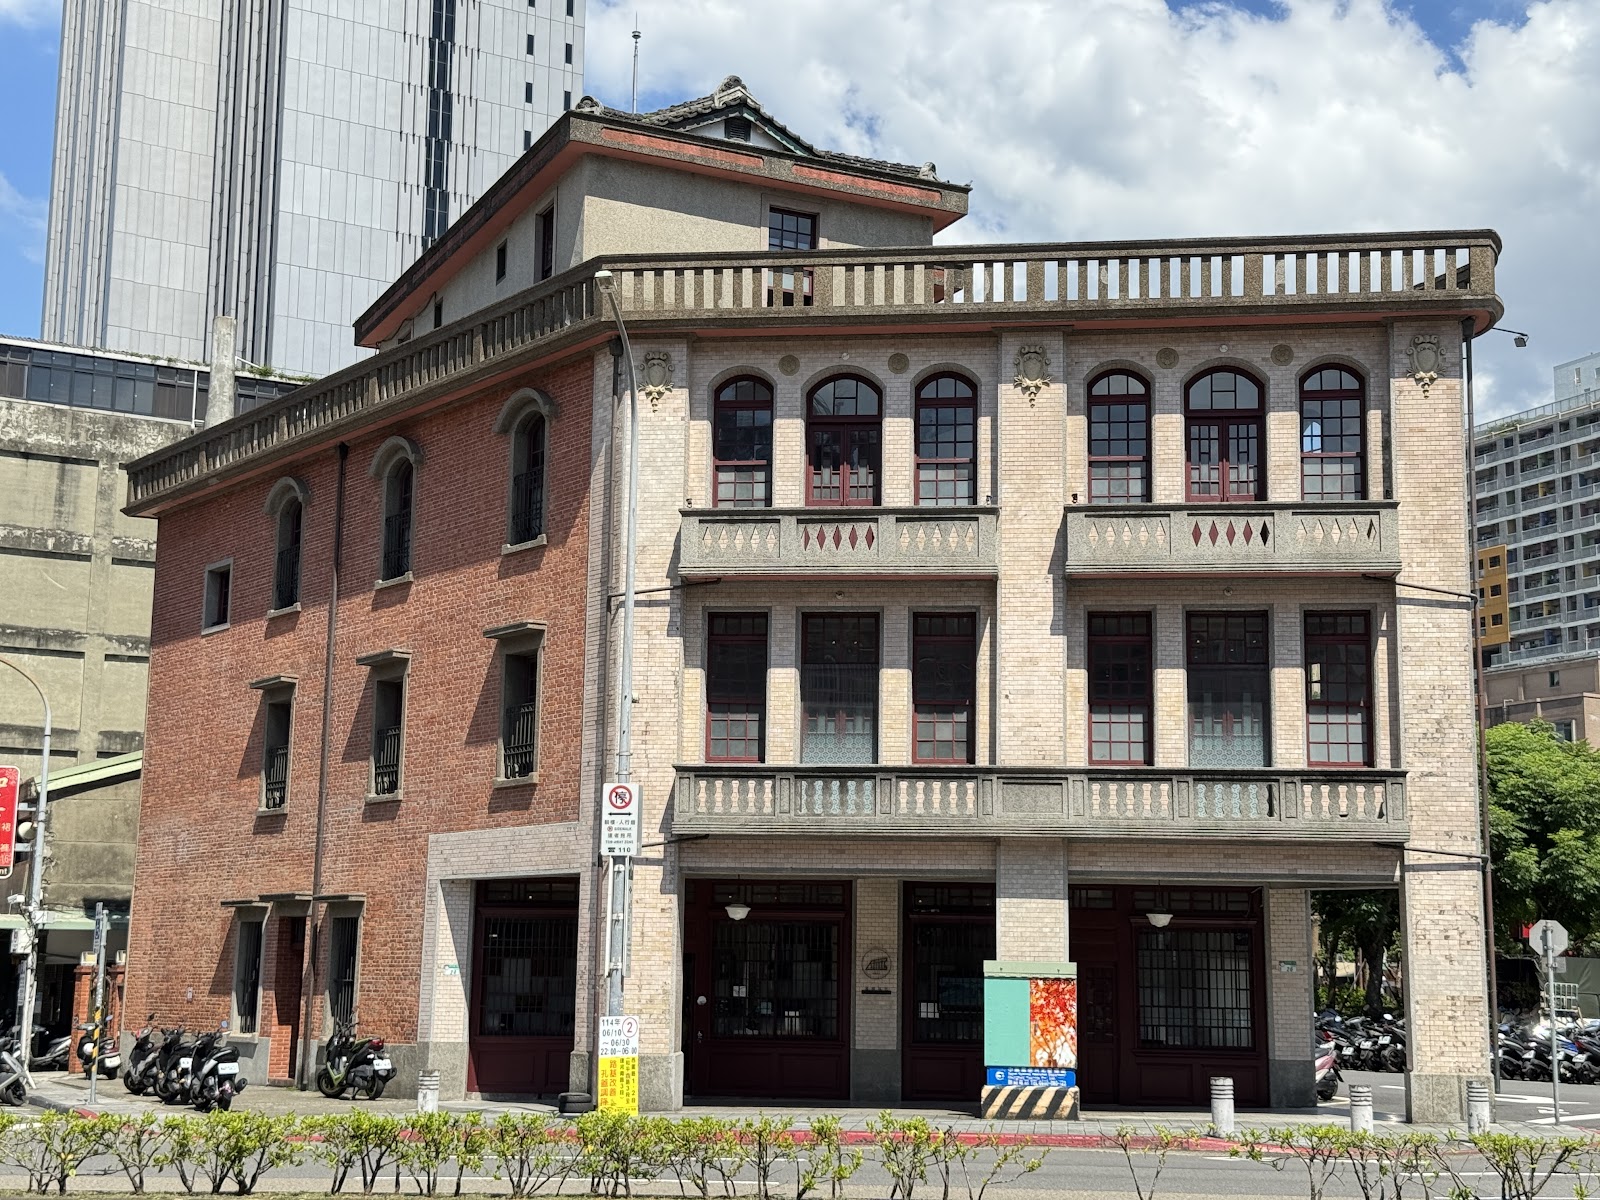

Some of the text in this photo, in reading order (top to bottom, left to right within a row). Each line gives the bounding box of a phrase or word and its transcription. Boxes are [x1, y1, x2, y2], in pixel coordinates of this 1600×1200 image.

[601, 1018, 621, 1027] 114年
[626, 1021, 633, 1033] 2
[602, 1029, 622, 1037] 06/10
